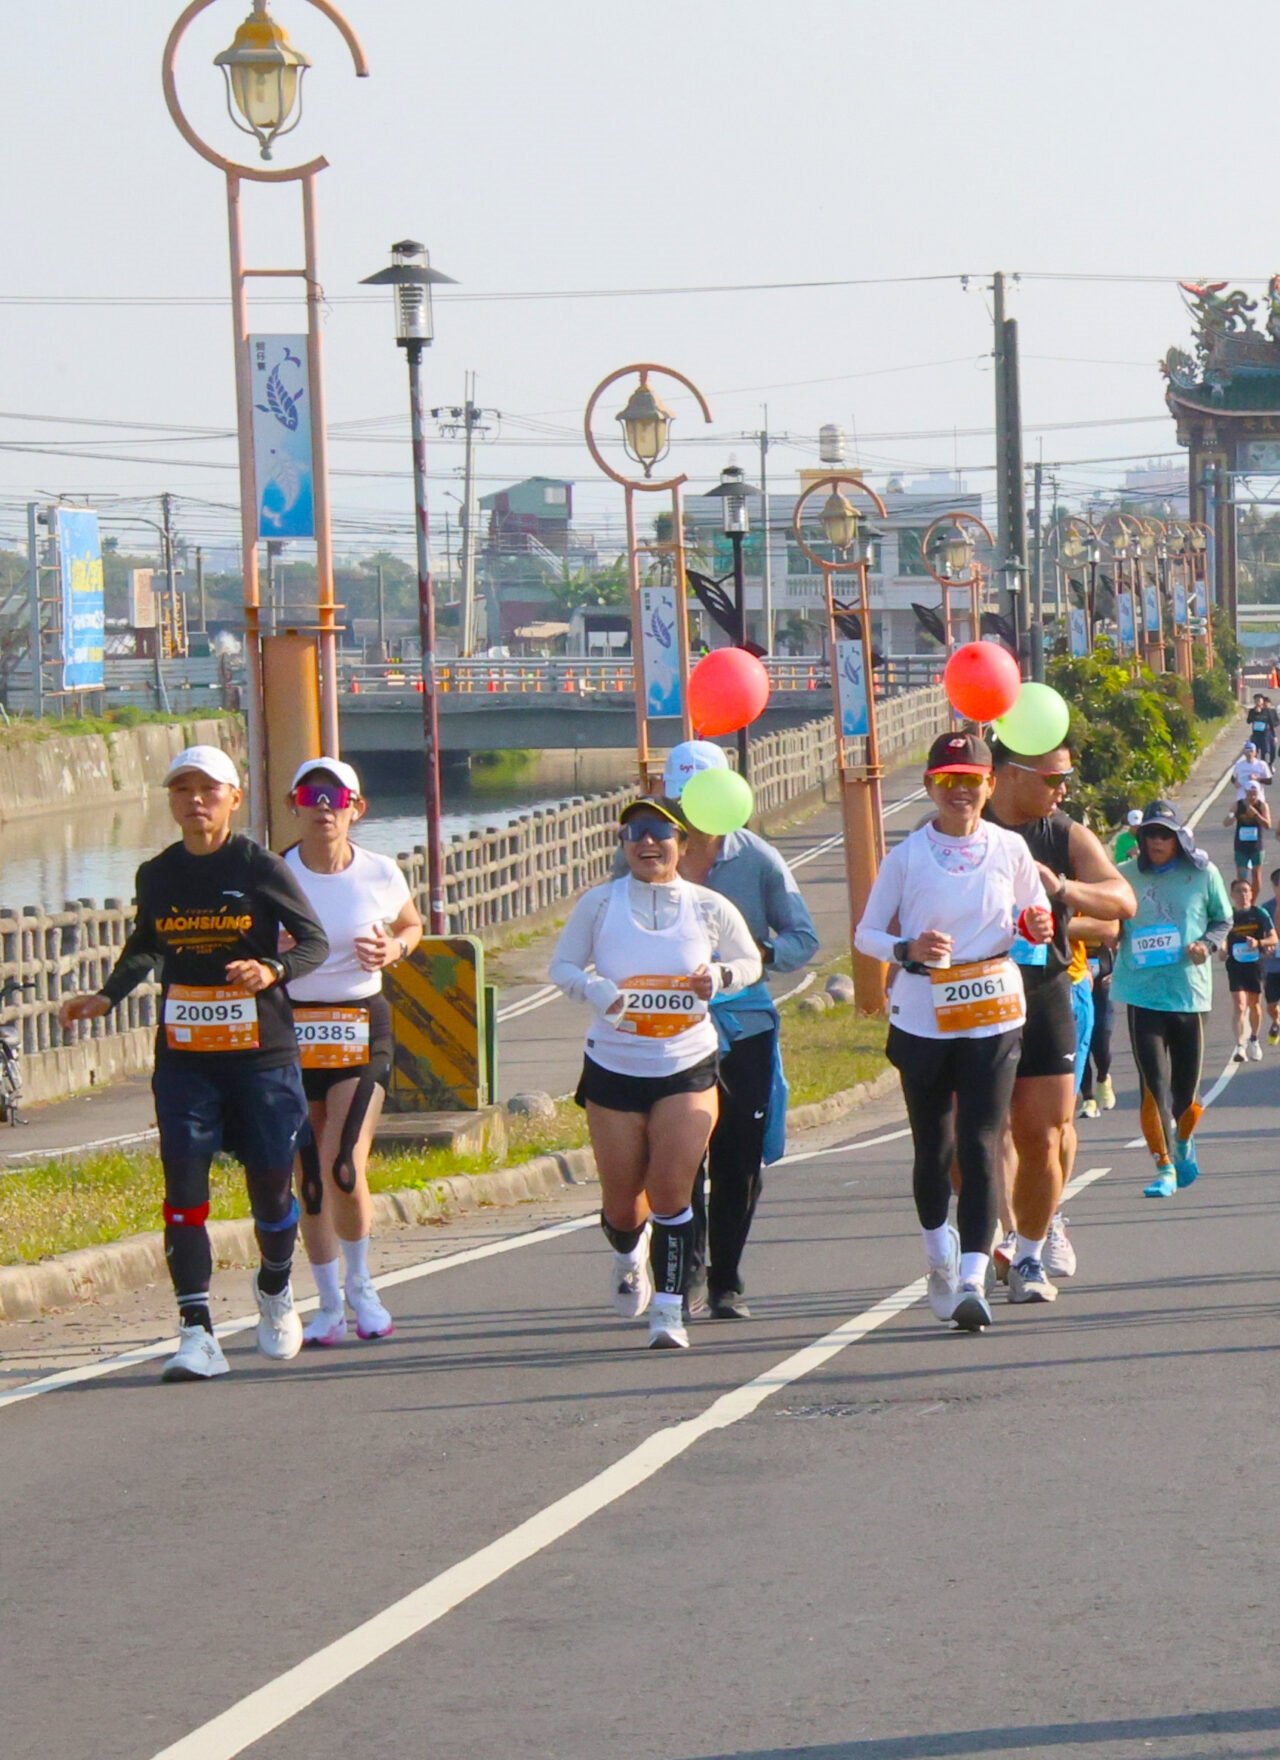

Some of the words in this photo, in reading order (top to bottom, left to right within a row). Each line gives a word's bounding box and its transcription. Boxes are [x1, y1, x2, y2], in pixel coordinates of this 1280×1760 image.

[155, 915, 253, 932] KAOHSIUNG
[1137, 935, 1172, 951] 10267
[944, 977, 1005, 1003] 20061
[627, 993, 694, 1011] 20060
[175, 1004, 243, 1022] 20095
[294, 1025, 356, 1041] 20385
